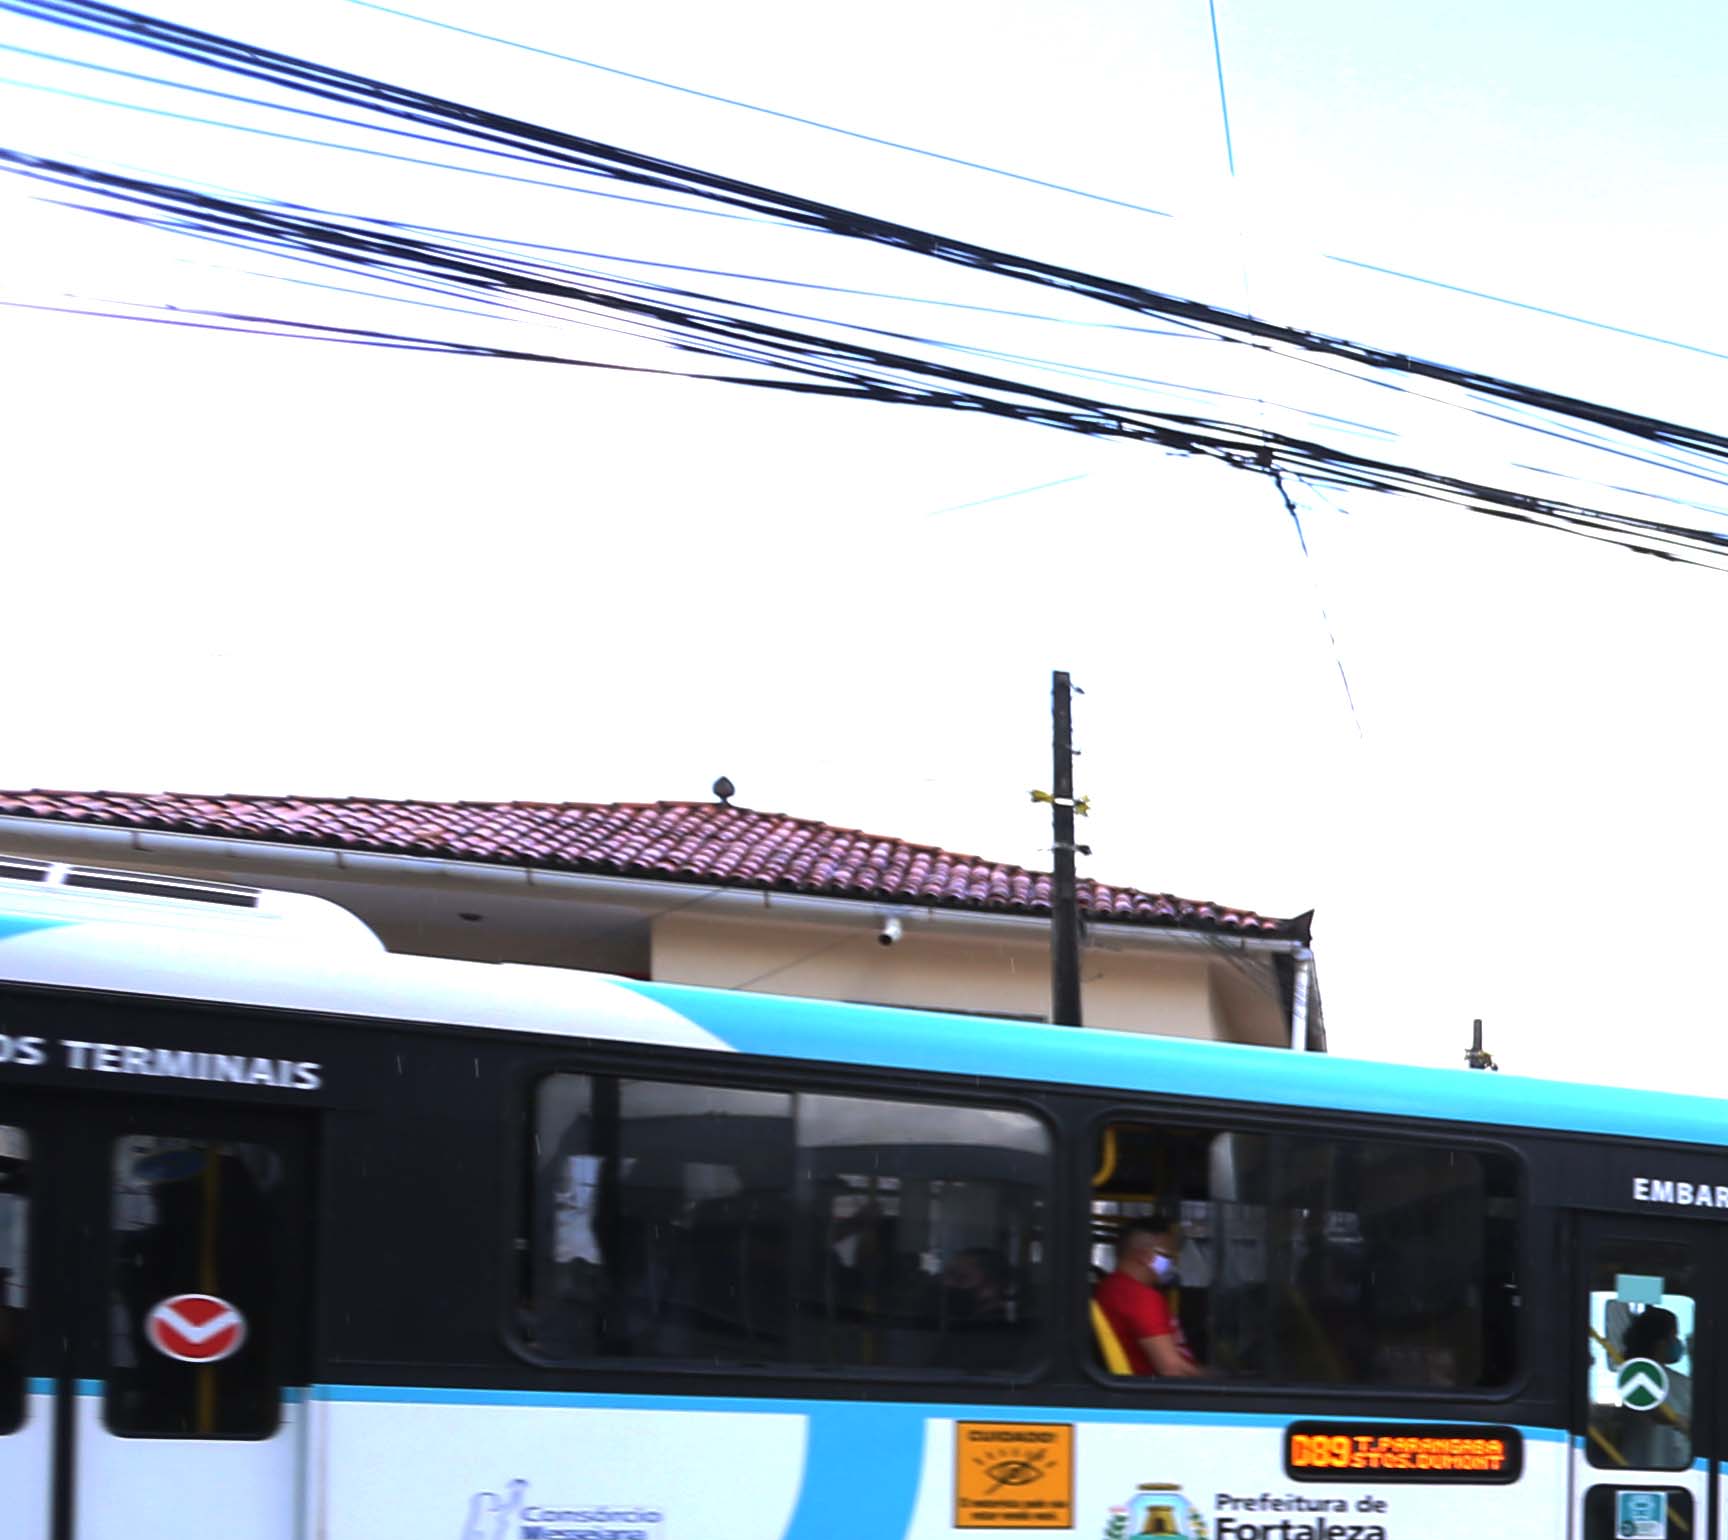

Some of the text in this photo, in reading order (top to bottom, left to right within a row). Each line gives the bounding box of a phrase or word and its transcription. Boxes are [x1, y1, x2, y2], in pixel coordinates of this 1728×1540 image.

[58, 1039, 323, 1090] TERMINAIS
[1215, 1492, 1388, 1514] Prefeitura de
